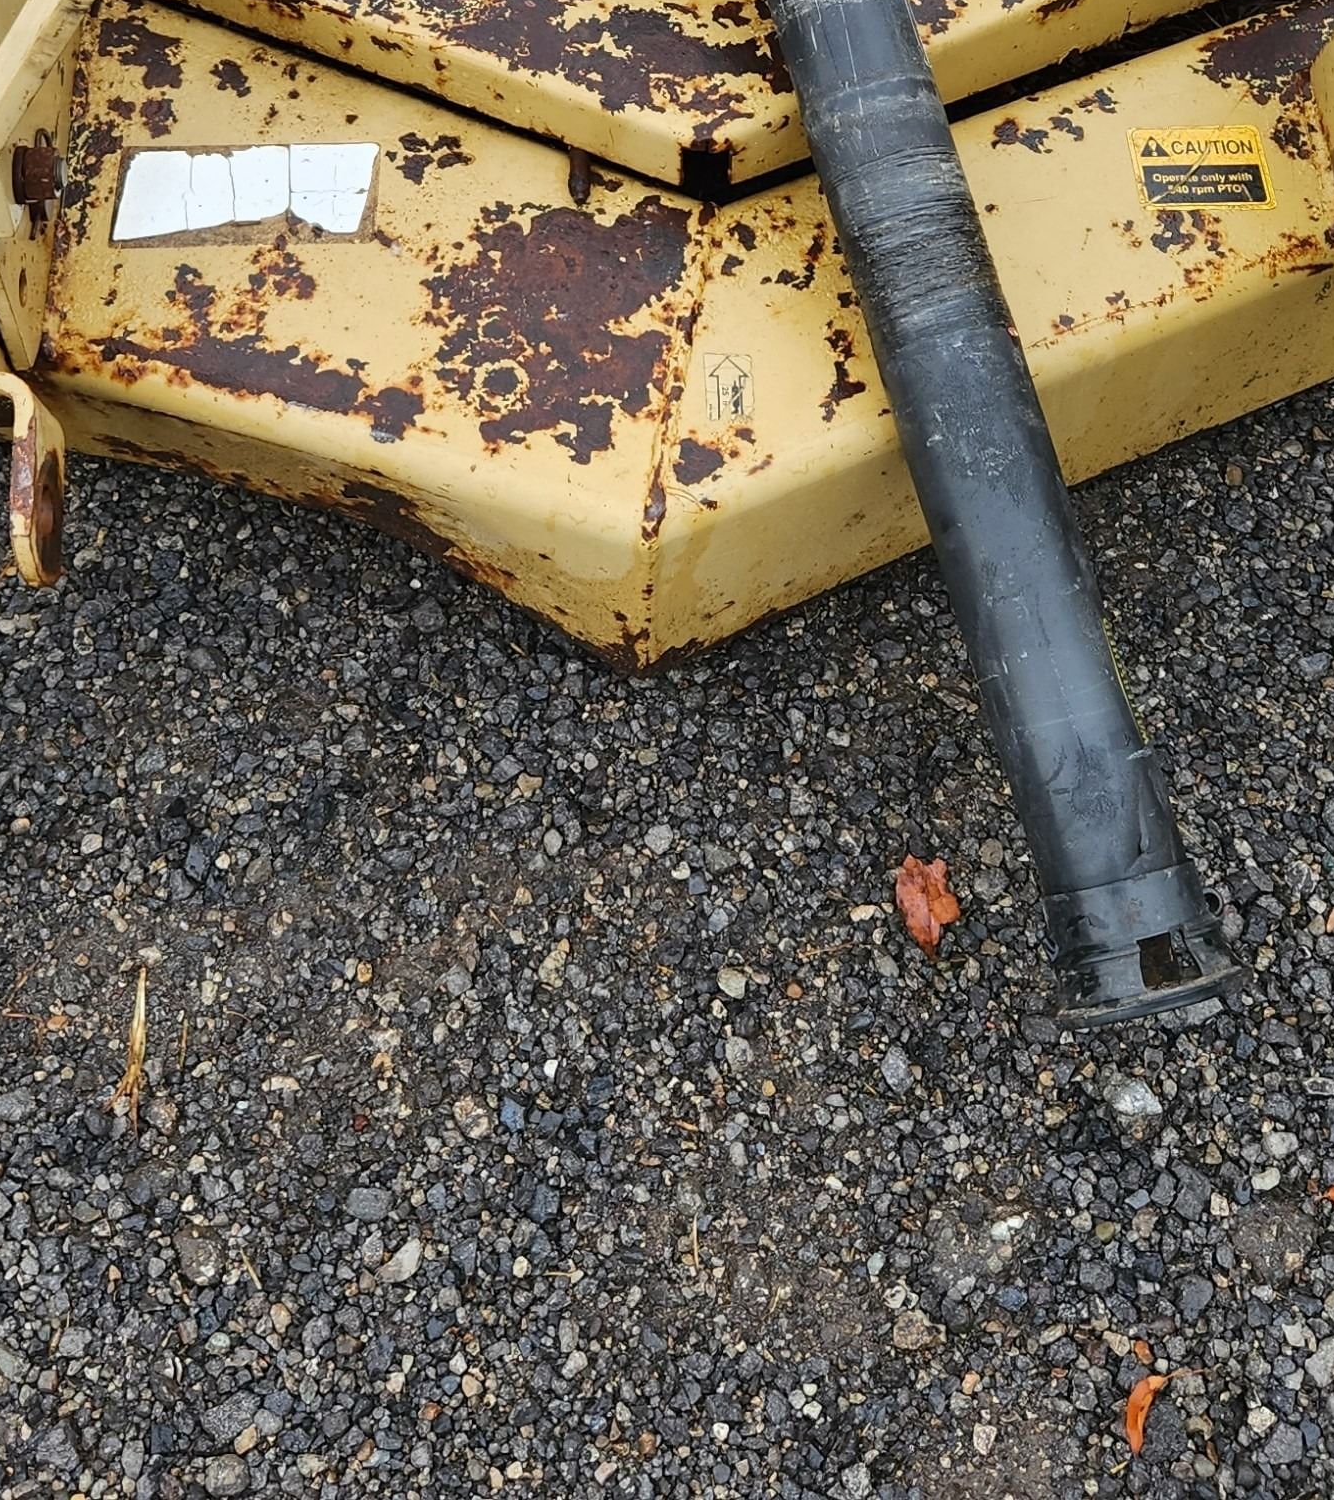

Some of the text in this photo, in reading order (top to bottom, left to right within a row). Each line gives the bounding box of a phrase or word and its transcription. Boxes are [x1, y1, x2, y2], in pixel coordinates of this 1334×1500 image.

[1170, 140, 1253, 156] CAUTION
[1153, 172, 1253, 184] Opere only with
[1192, 186, 1214, 195] rpm
[1218, 183, 1242, 194] PTO
